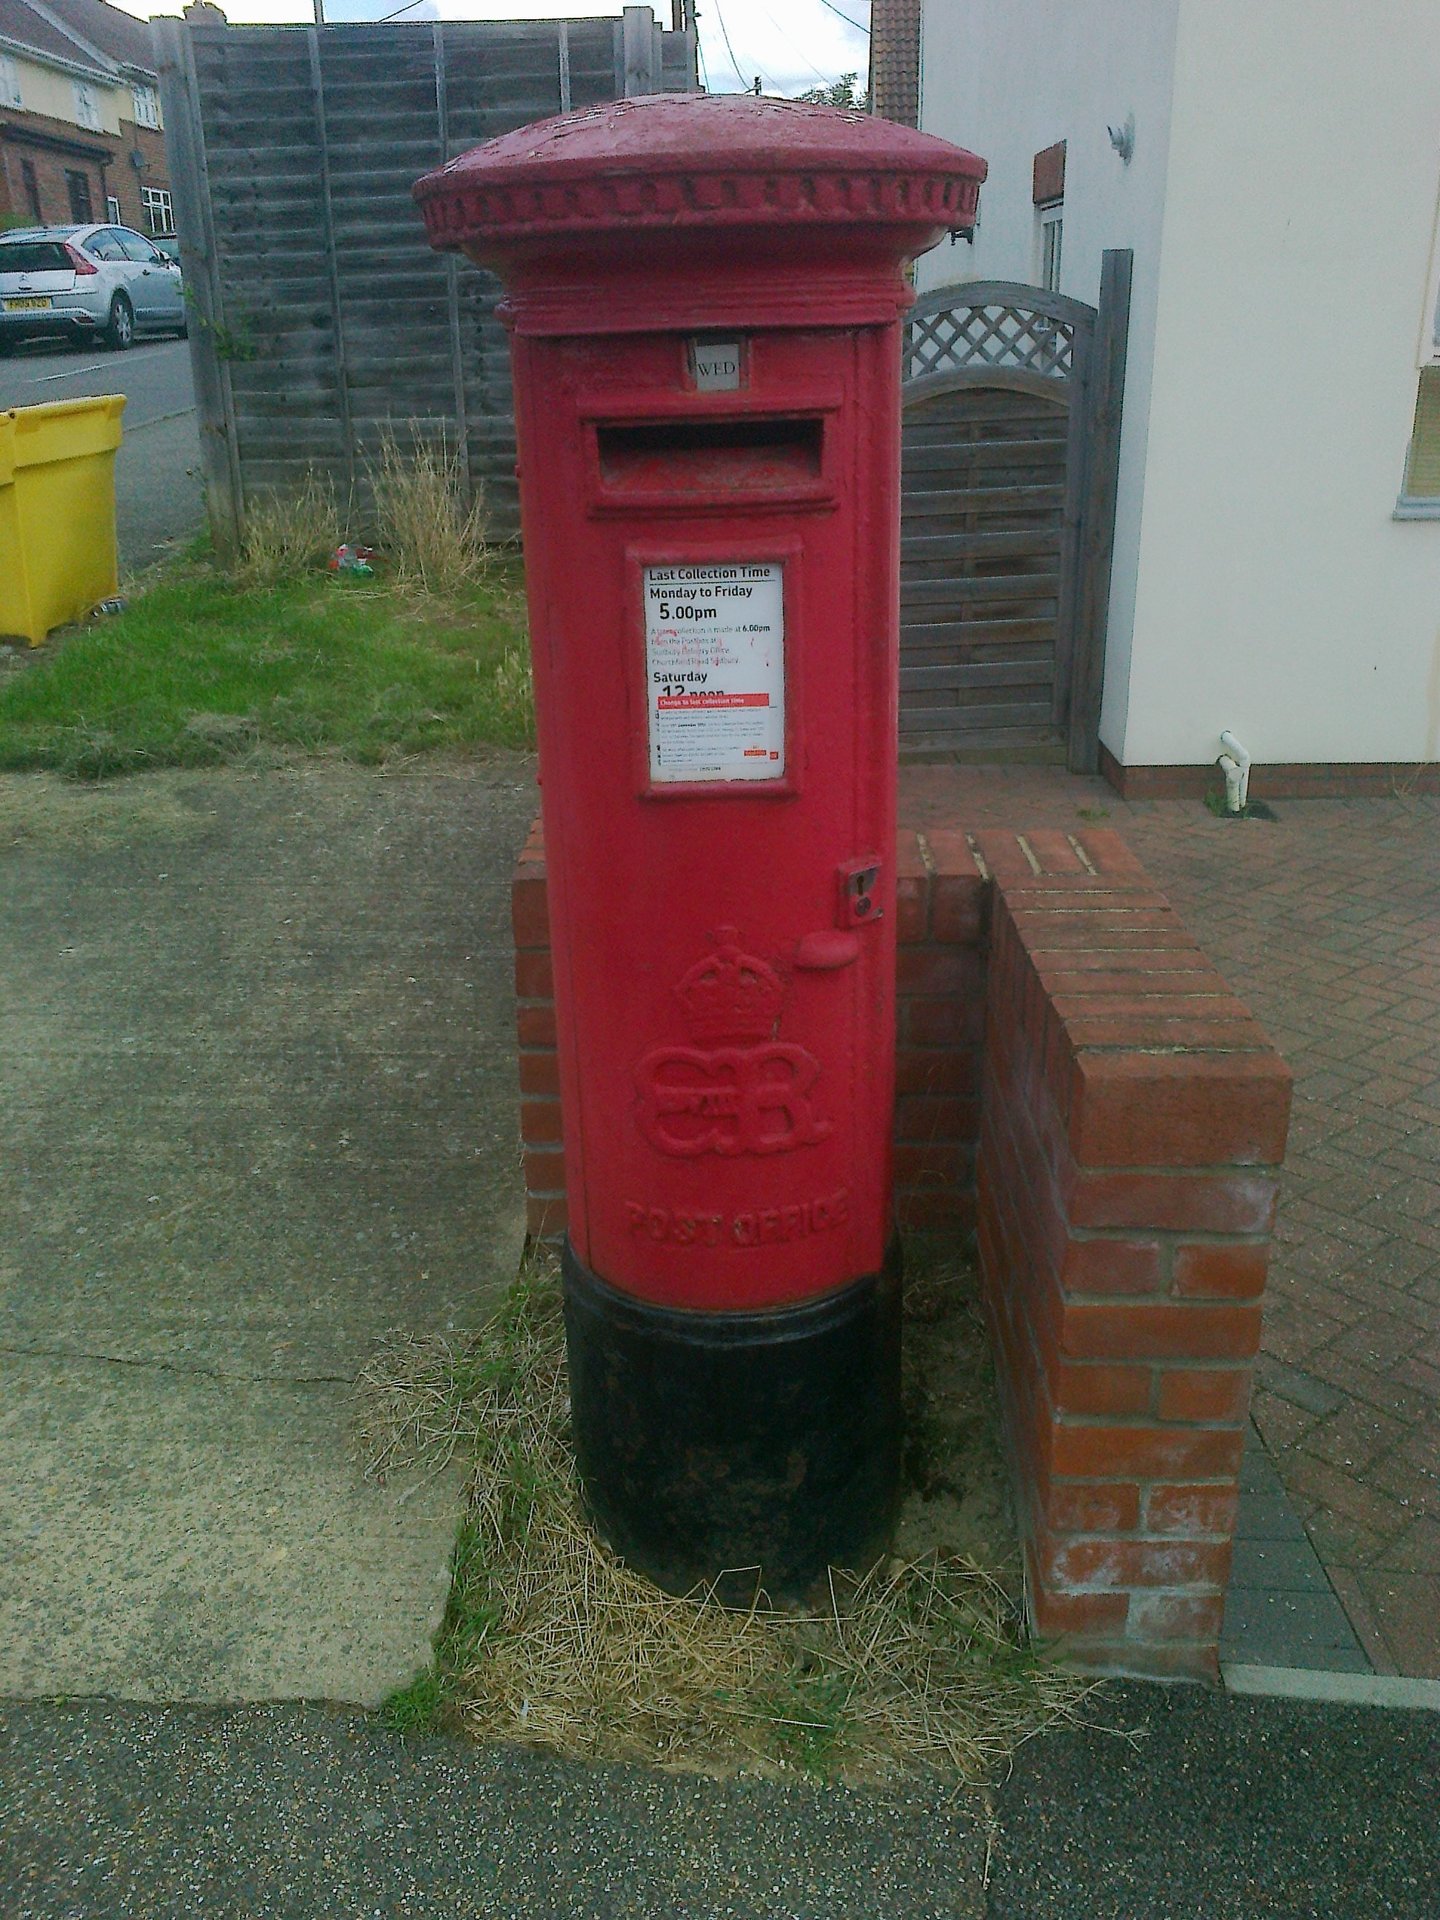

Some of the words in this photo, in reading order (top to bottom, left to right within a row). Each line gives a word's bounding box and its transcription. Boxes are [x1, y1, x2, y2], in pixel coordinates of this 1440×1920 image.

[698, 361, 736, 376] WED
[649, 569, 675, 581] Last
[677, 567, 737, 580] Collection
[739, 566, 771, 578] Time
[650, 587, 697, 600] Monday
[699, 588, 712, 598] to
[714, 585, 753, 598] Friday
[659, 602, 717, 621] 5.00pm
[742, 624, 771, 633] 6.00pm
[653, 671, 708, 684] Saturday
[662, 685, 686, 697] 12
